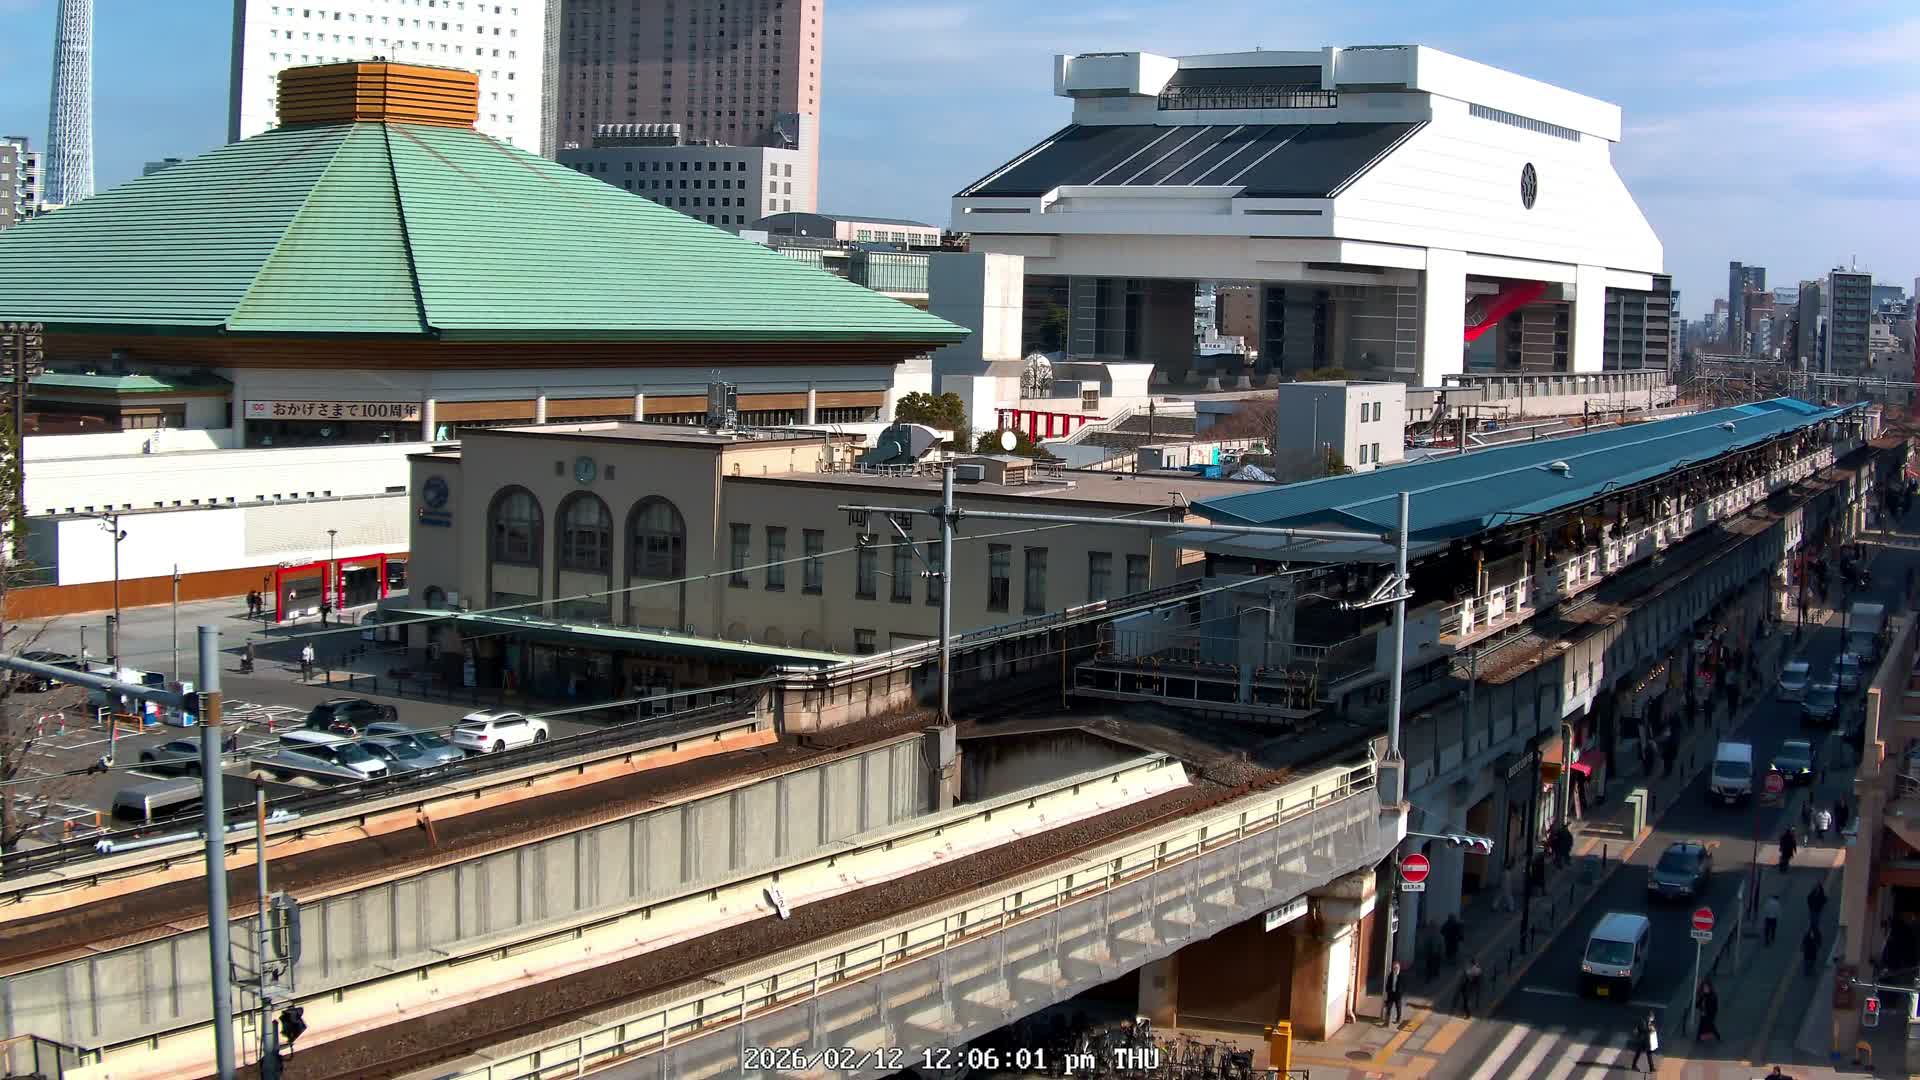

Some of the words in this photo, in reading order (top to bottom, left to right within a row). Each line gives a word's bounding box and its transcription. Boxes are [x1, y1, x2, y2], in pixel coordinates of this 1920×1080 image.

[273, 403, 417, 417] おかげさまで100周年
